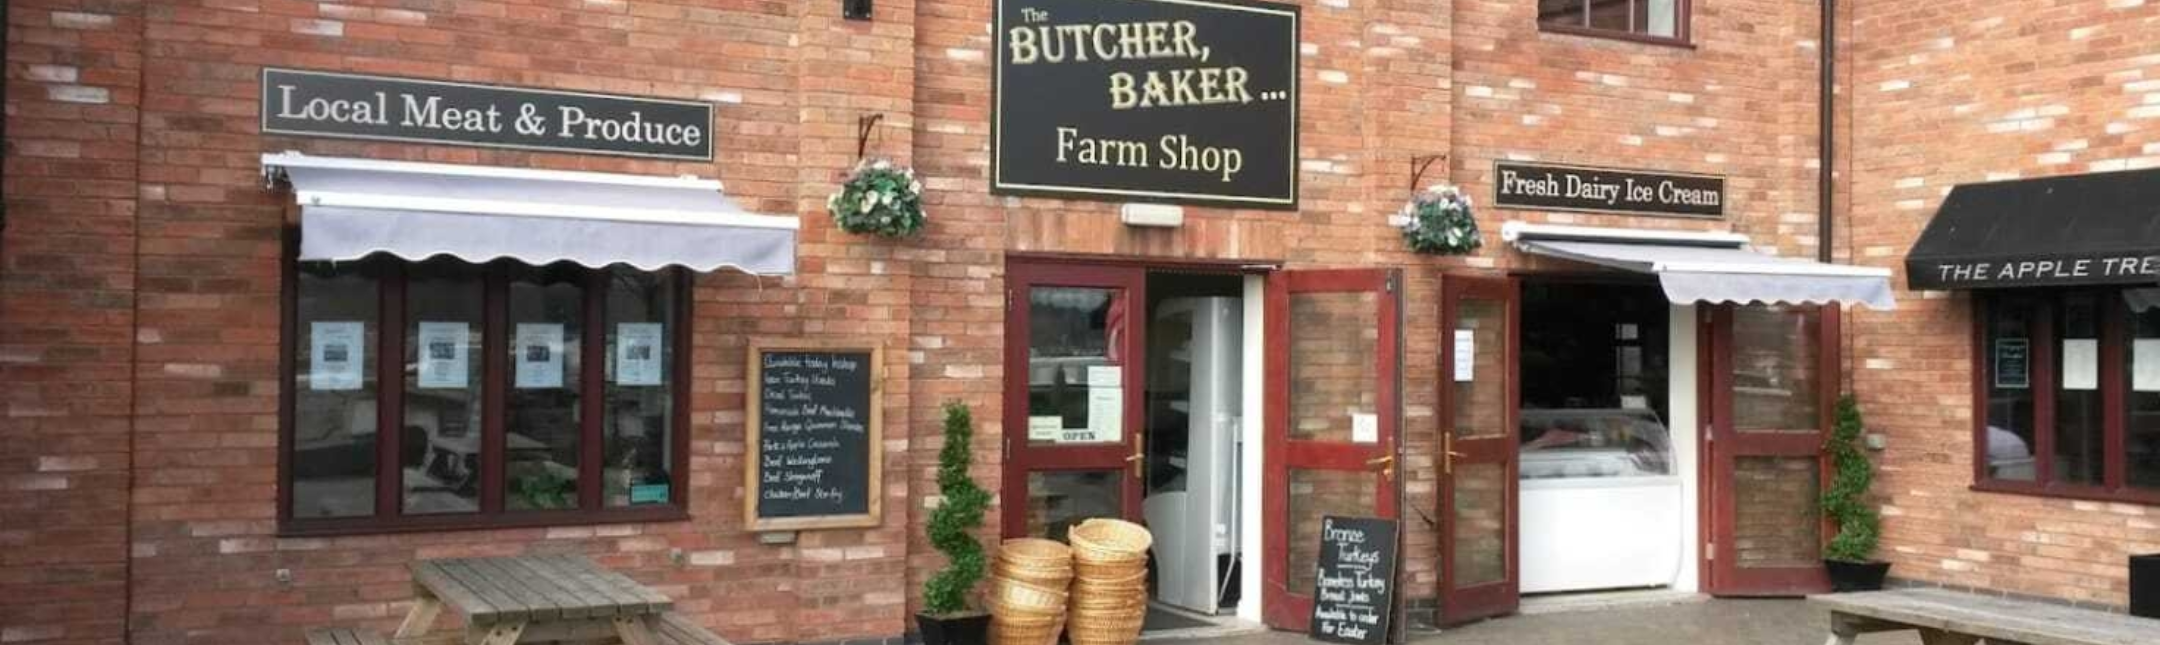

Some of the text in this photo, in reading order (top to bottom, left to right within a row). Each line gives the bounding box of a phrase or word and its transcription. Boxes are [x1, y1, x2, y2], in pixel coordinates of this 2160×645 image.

[1021, 8, 1048, 23] The
[1009, 20, 1210, 64] BUTCHER,
[1110, 67, 1253, 109] BAKER
[276, 84, 701, 146] Local Meat & Produce
[1056, 127, 1242, 182] Farm Shop
[1501, 170, 1719, 206] Fresh Dairy Ice Cream
[1938, 263, 1991, 281] THE
[1997, 259, 2092, 280] APPLE
[1063, 432, 1096, 441] OPEN
[763, 454, 783, 468] Beef
[1325, 518, 1365, 543] Bronze
[1336, 542, 1380, 571] Turkeys
[1354, 570, 1385, 595] Turkey
[1337, 621, 1369, 640] Easter
